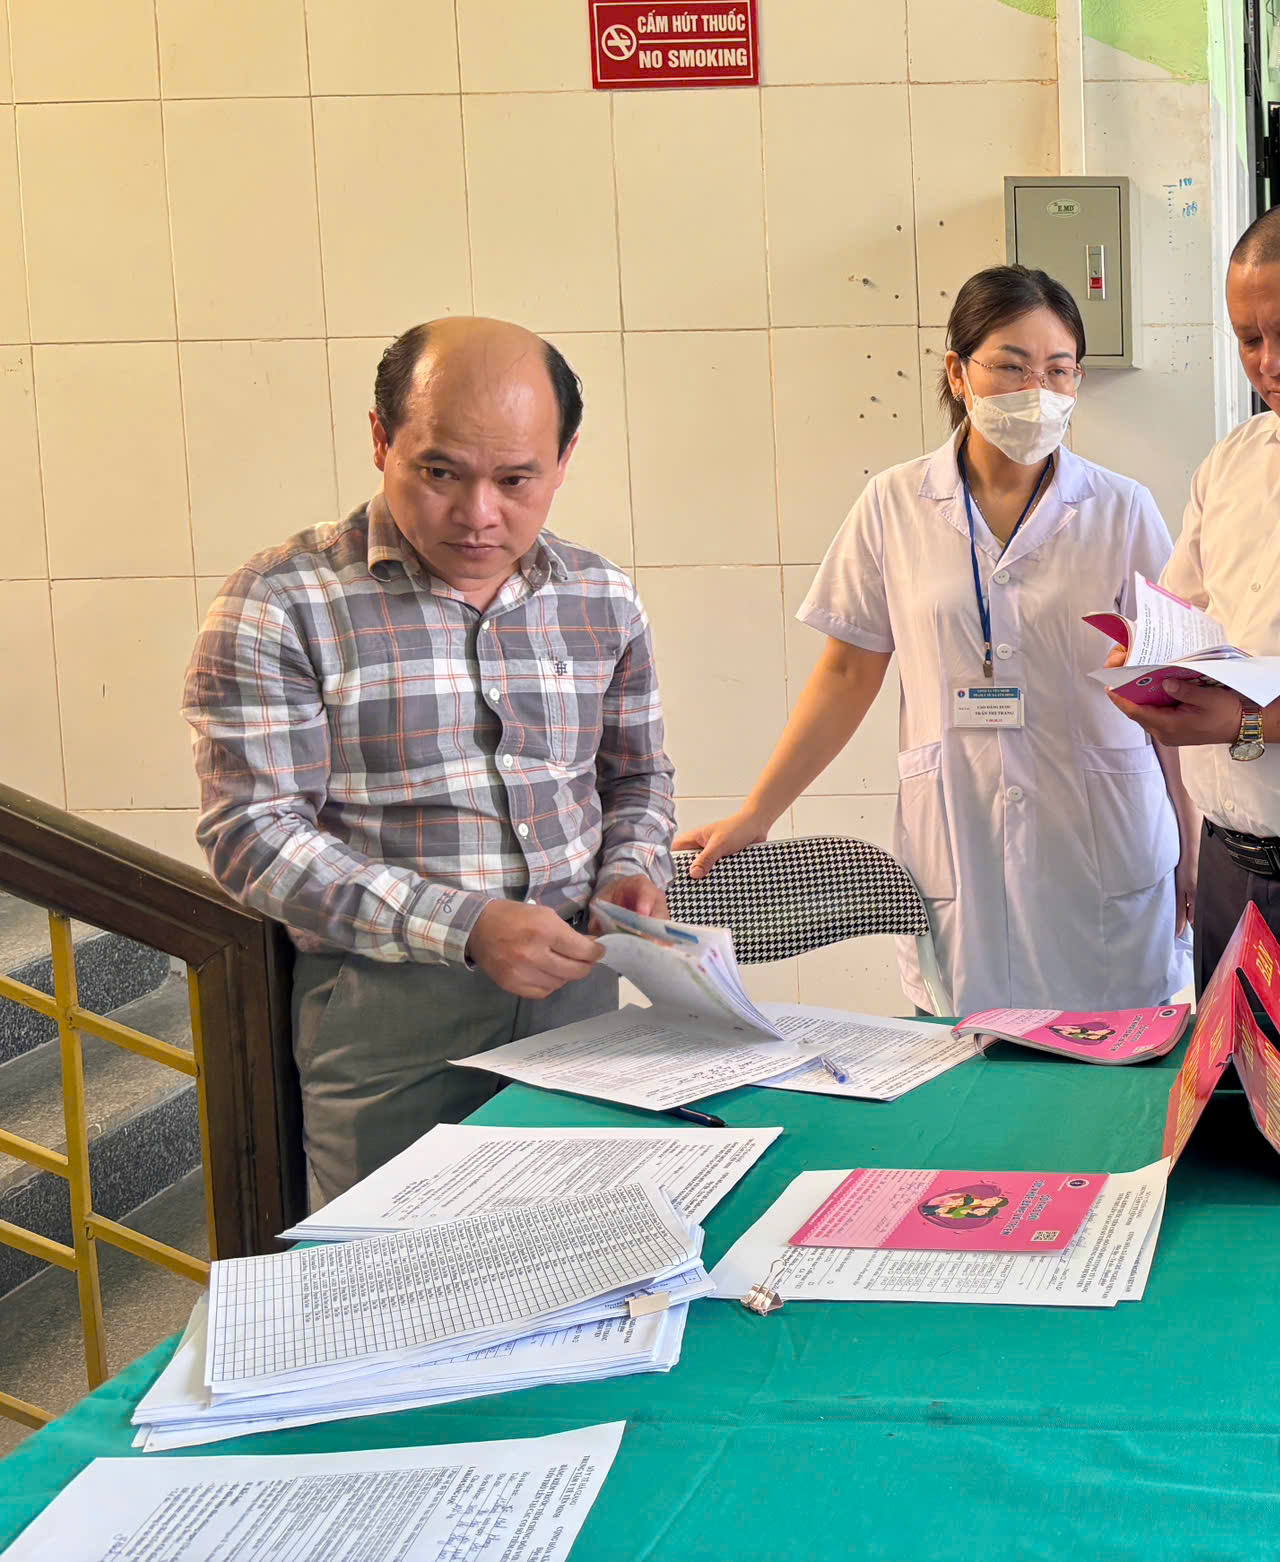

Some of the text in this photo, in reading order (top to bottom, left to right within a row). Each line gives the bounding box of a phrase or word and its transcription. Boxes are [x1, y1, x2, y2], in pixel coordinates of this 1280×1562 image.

[637, 8, 746, 33] CẤM HÚT THUỐC
[639, 48, 748, 68] NO SMOKING
